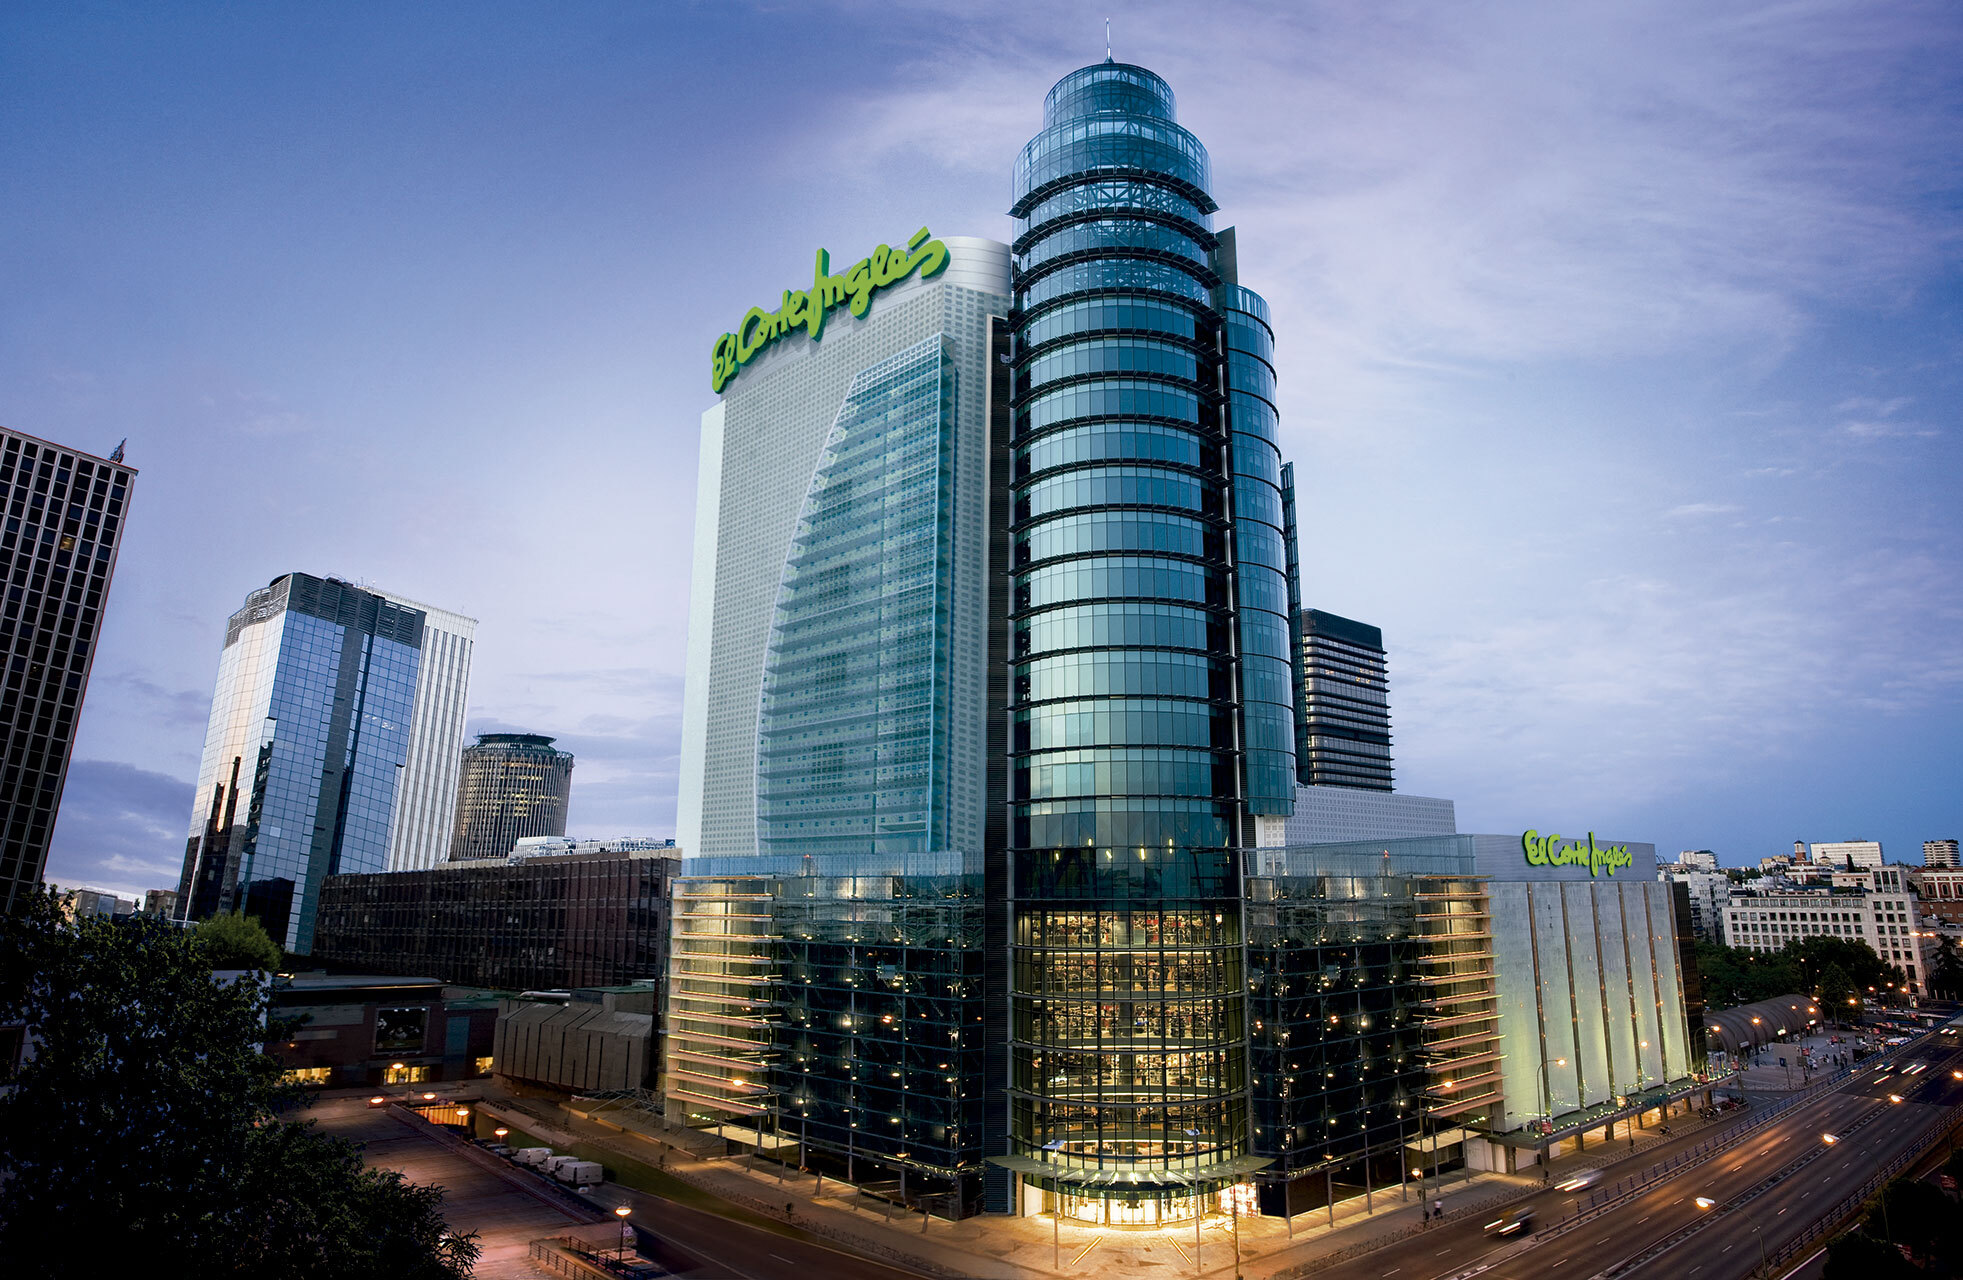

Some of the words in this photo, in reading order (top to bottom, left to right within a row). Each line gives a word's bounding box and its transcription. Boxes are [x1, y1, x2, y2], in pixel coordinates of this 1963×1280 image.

[712, 332, 739, 394] El
[737, 289, 809, 367] Corte
[807, 225, 951, 343] Inglés
[1522, 829, 1549, 867] El
[1547, 833, 1590, 867] Corte
